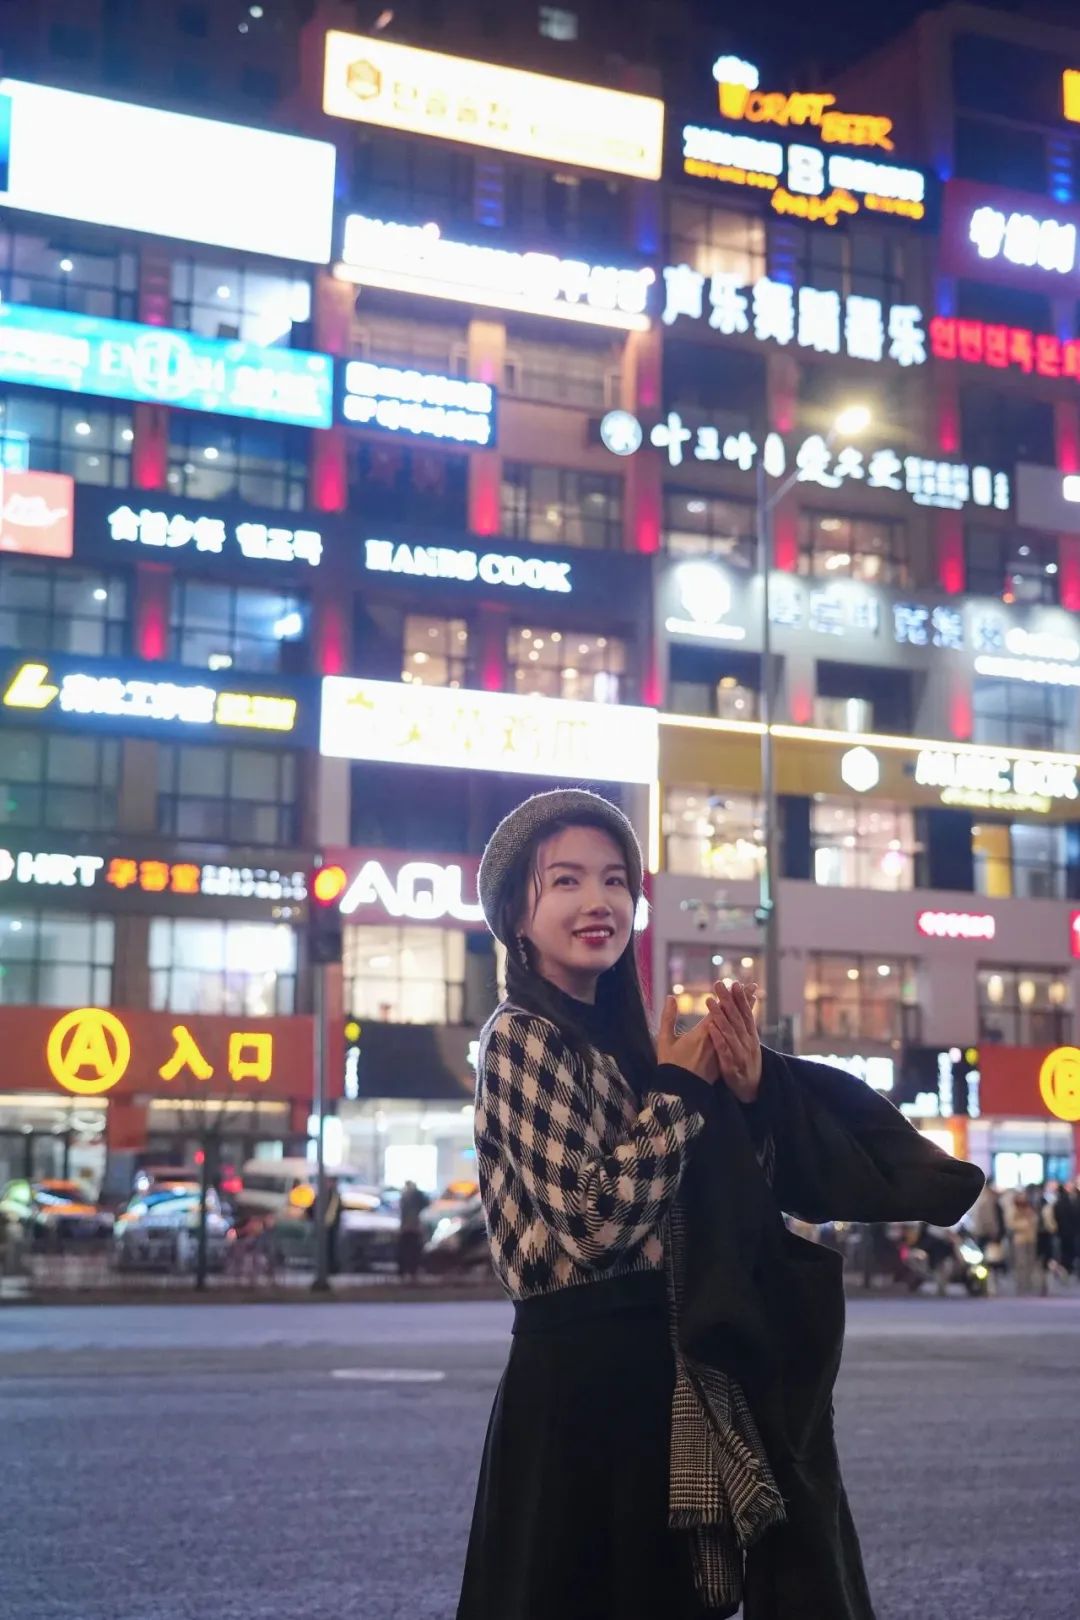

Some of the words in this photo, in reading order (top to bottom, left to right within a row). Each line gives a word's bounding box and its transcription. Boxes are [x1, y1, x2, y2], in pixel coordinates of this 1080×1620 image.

[744, 91, 836, 126] CRAFT
[821, 112, 893, 151] BEER
[478, 554, 572, 593] COOK
[158, 1025, 273, 1082] 入口
